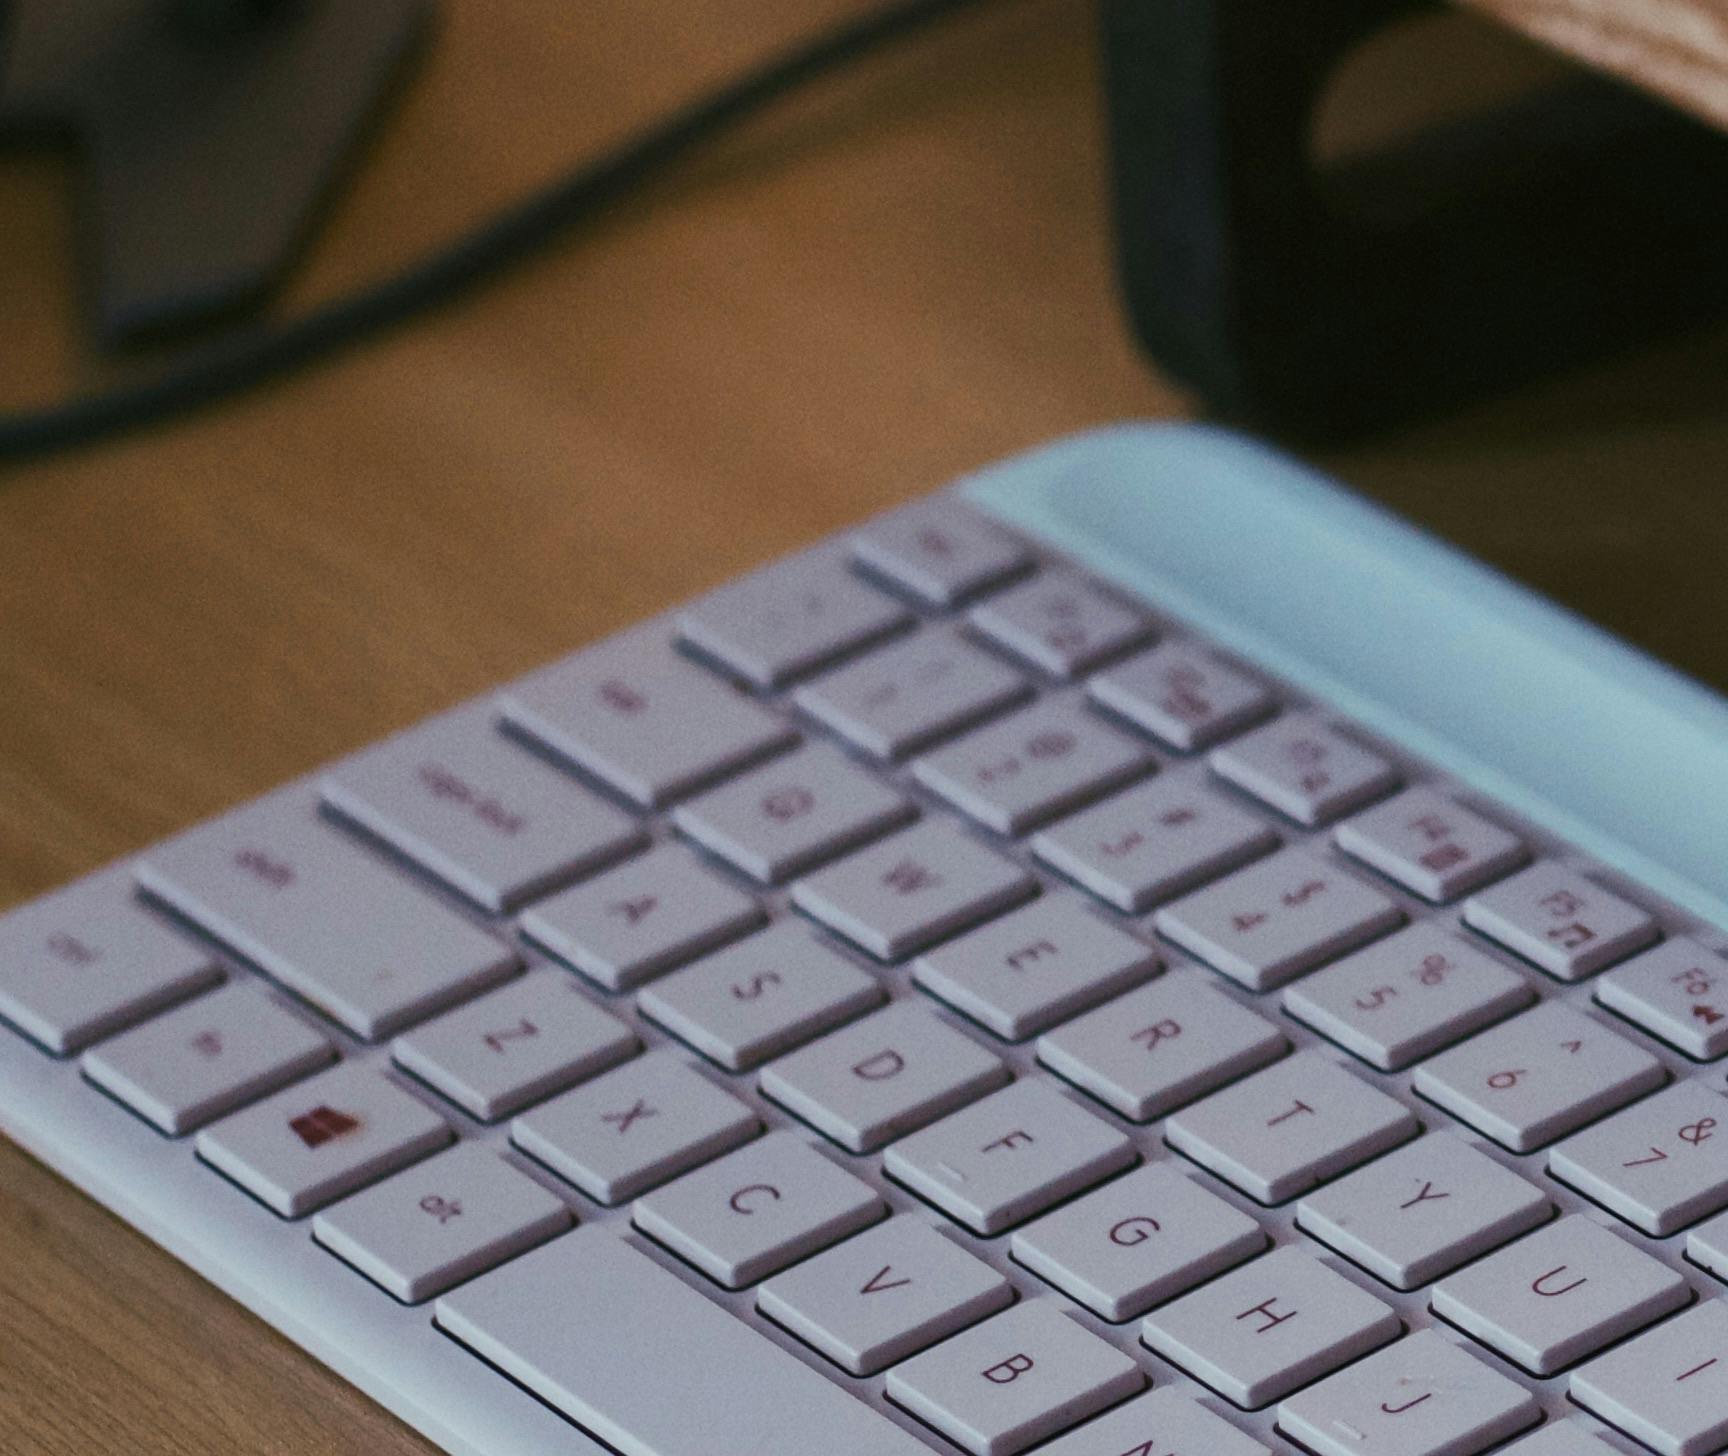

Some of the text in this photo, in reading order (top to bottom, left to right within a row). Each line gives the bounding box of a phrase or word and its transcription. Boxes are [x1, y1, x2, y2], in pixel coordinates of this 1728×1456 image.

[1005, 940, 1060, 972] E
[730, 971, 782, 1001] S
[1354, 985, 1398, 1011] 5
[482, 1019, 539, 1054] Z
[1131, 1018, 1183, 1052] R
[851, 1049, 906, 1082] D
[1486, 1068, 1528, 1091] 6
[600, 1098, 659, 1135] X
[1267, 1099, 1315, 1127] T
[981, 1129, 1035, 1153] F
[1677, 1117, 1718, 1147] &
[1622, 1146, 1669, 1169] 7
[728, 1184, 782, 1216] C
[1400, 1181, 1450, 1210] Y
[1108, 1216, 1161, 1247] G
[859, 1264, 911, 1296] V
[1530, 1264, 1588, 1298] U
[1235, 1296, 1298, 1334] H
[981, 1352, 1035, 1385] B
[1379, 1392, 1433, 1415] J
